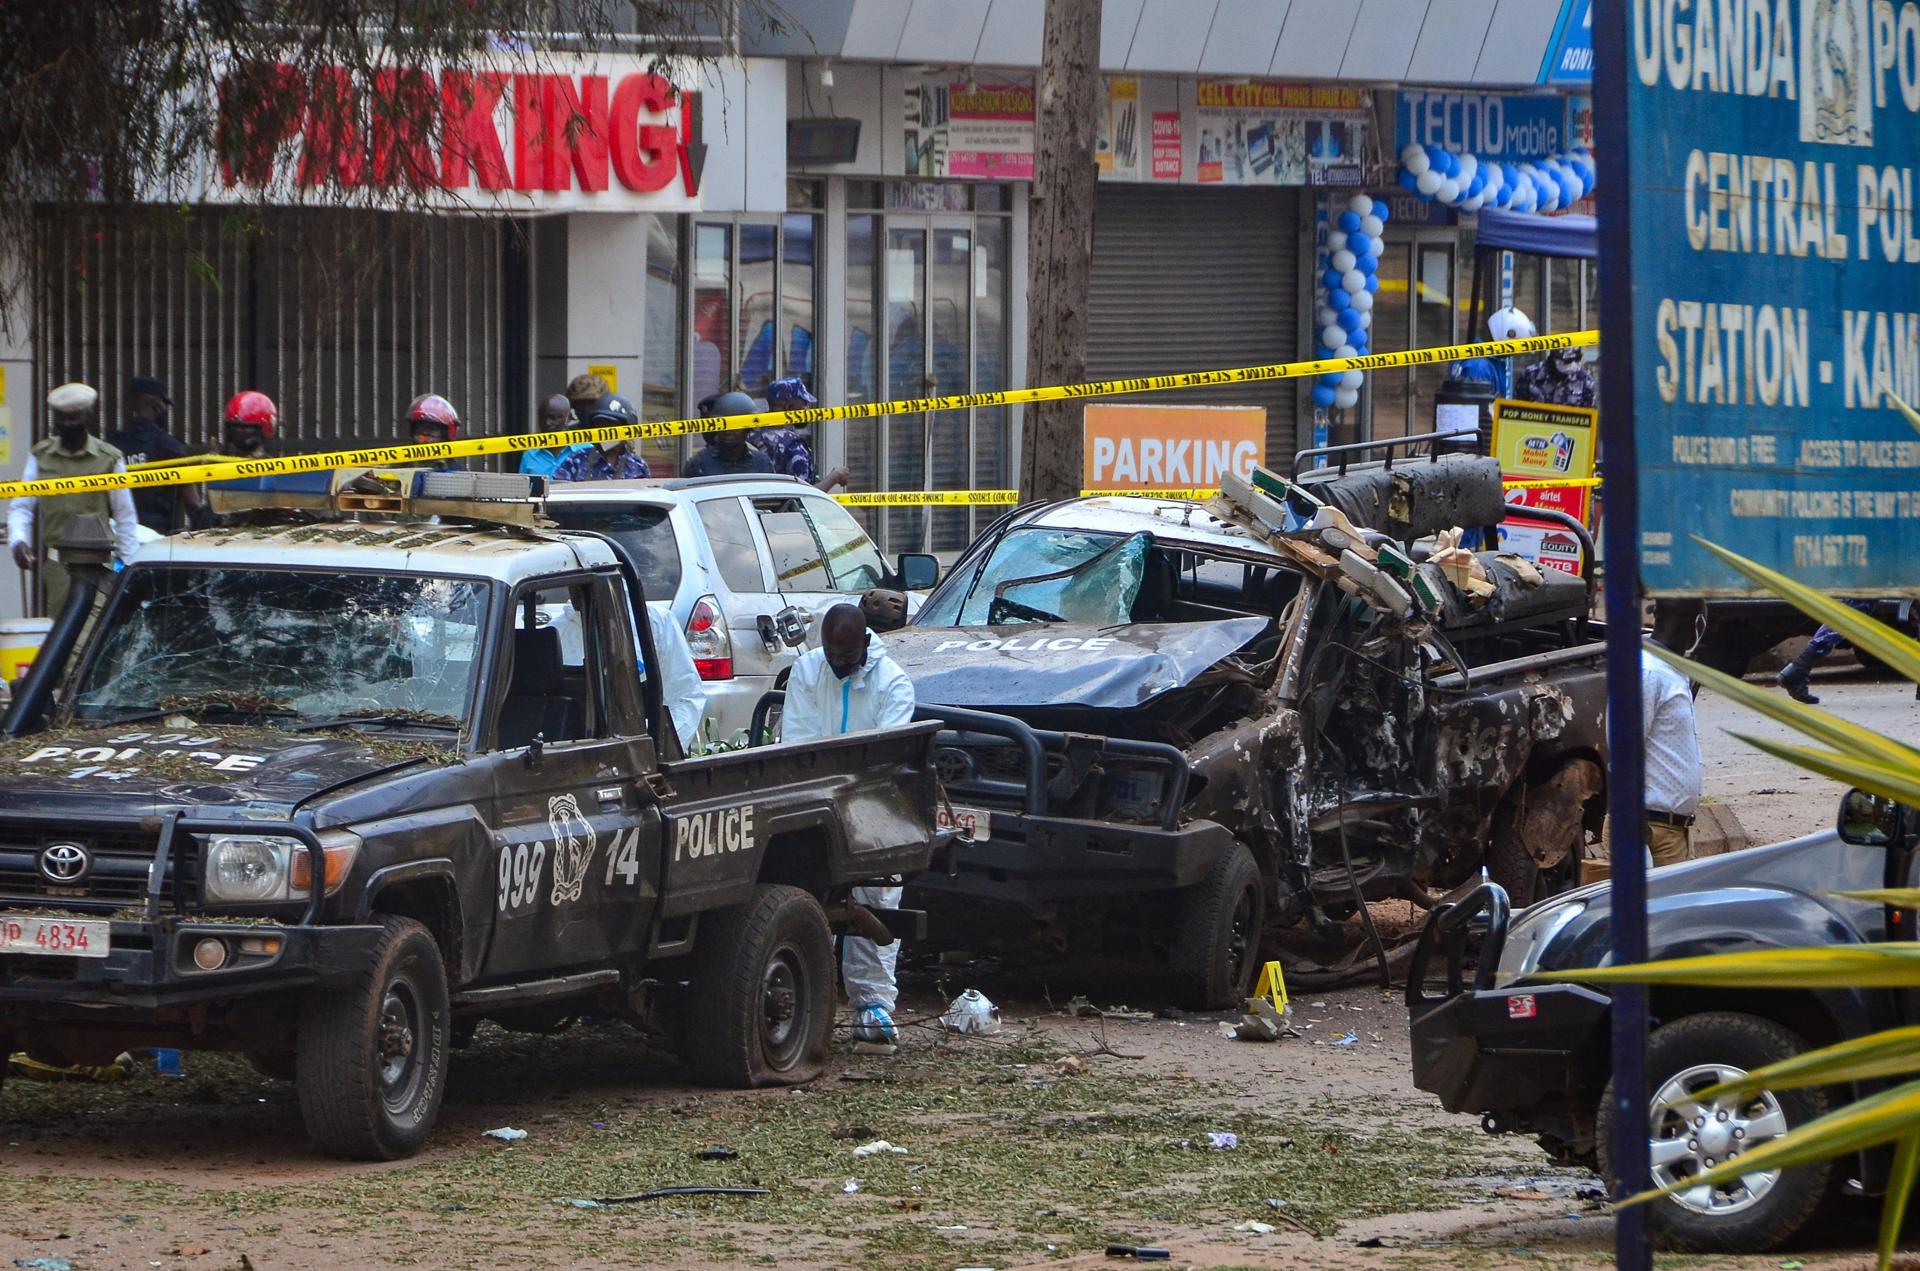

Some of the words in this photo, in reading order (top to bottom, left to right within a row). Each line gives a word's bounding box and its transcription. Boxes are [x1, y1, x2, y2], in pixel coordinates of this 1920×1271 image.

[1634, 0, 1797, 100] UGANDA
[1200, 82, 1228, 106] CELL
[1232, 83, 1263, 106] CITY
[216, 62, 680, 192] PARKING
[1403, 93, 1504, 152] TECNO
[1685, 149, 1848, 259] CENTRAL
[1656, 298, 1809, 408] STATION
[1521, 410, 1549, 422] MONEY
[1552, 414, 1590, 426] TRANSFER
[1093, 437, 1258, 484] PARKING
[1751, 435, 1776, 464] FREE
[1540, 490, 1561, 502] airtel
[1542, 542, 1577, 553] EQUITY
[932, 637, 1117, 653] POLICE
[605, 827, 641, 886] 14
[675, 805, 755, 862] POLICE
[499, 841, 545, 912] 999
[35, 923, 89, 950] 4834
[1274, 967, 1284, 1003] 4
[412, 1025, 442, 1124] DUNLOP
